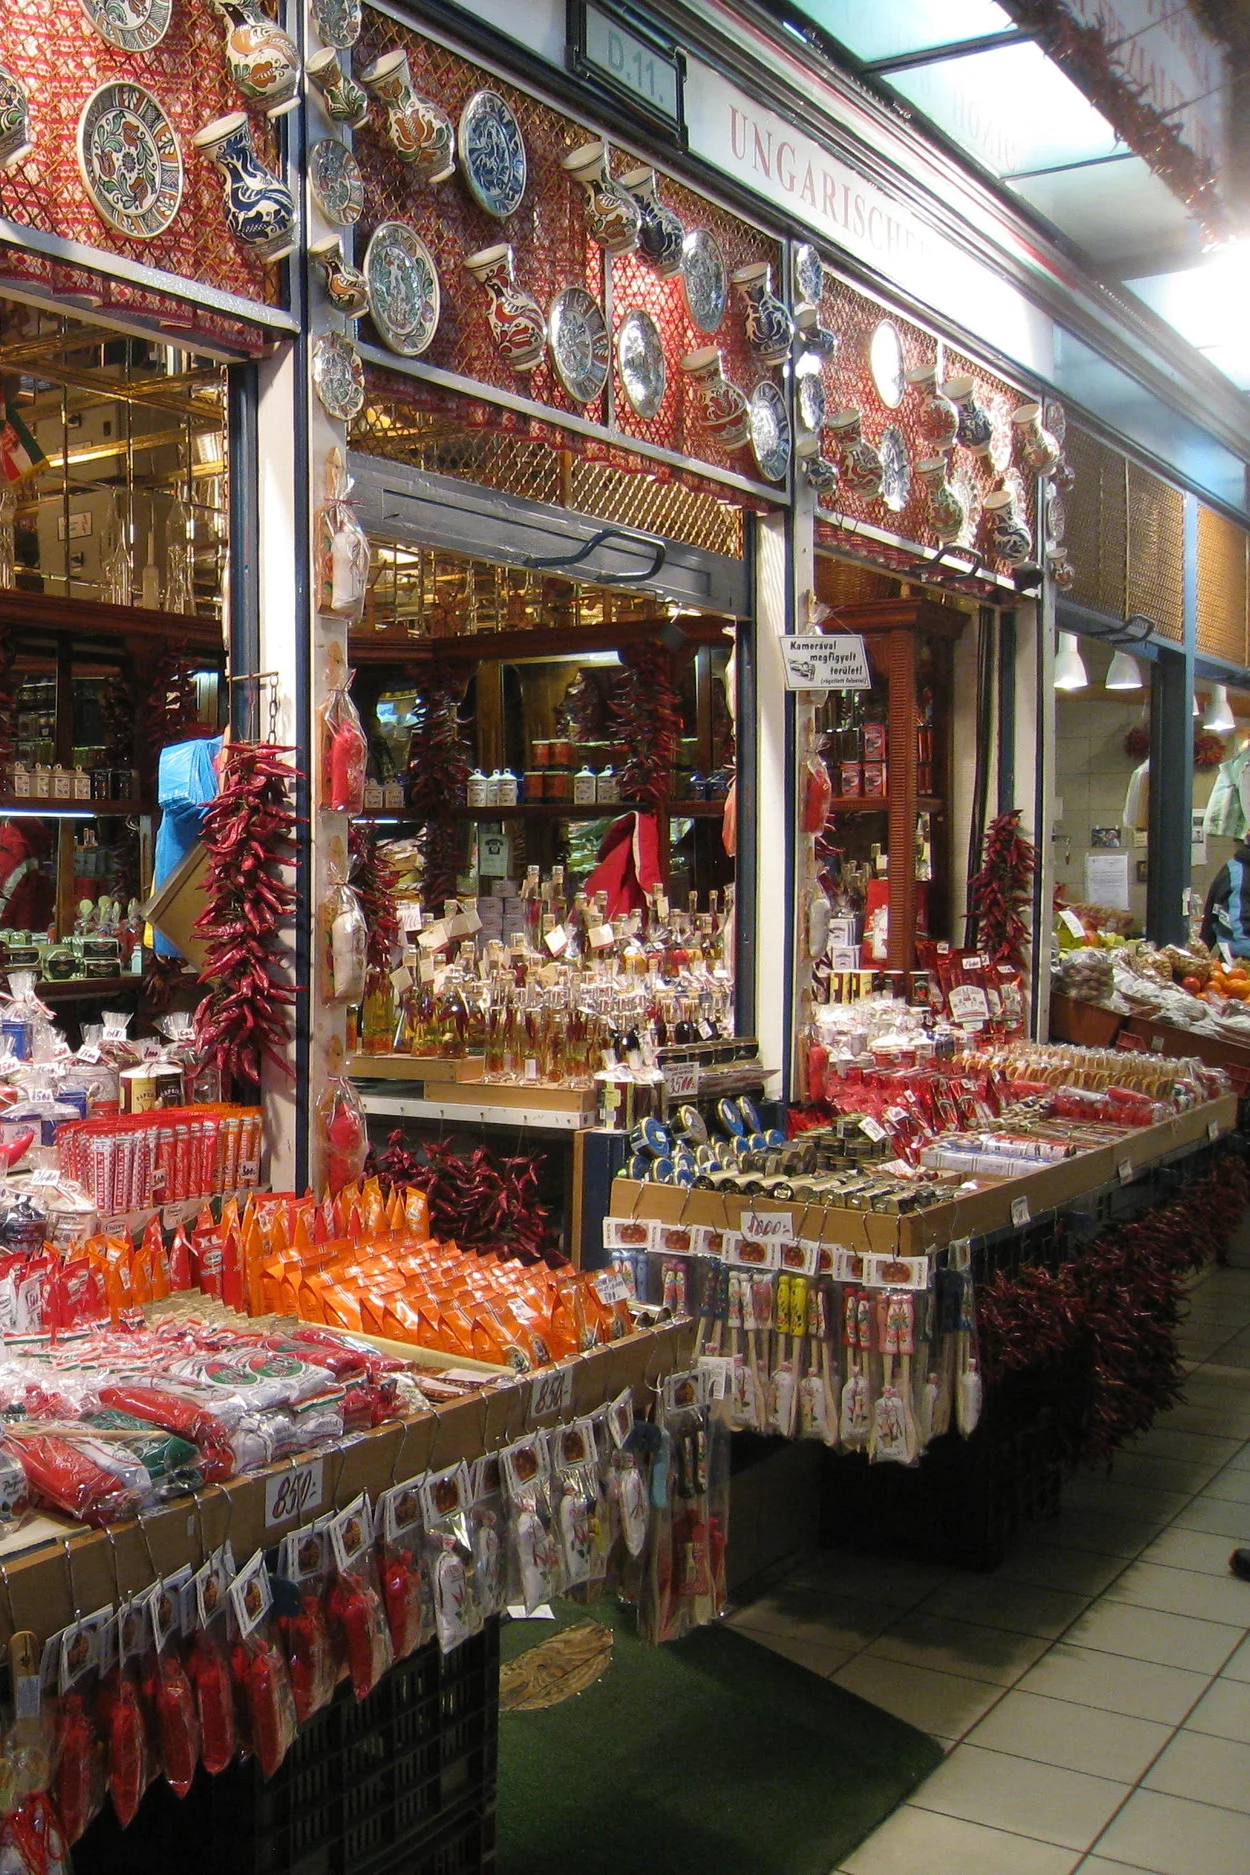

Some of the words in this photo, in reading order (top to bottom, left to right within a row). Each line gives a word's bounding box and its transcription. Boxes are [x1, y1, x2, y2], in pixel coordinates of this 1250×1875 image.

[727, 104, 920, 256] UNGARISCH
[790, 640, 837, 651] Kamerával
[810, 651, 857, 665] megfigyelt
